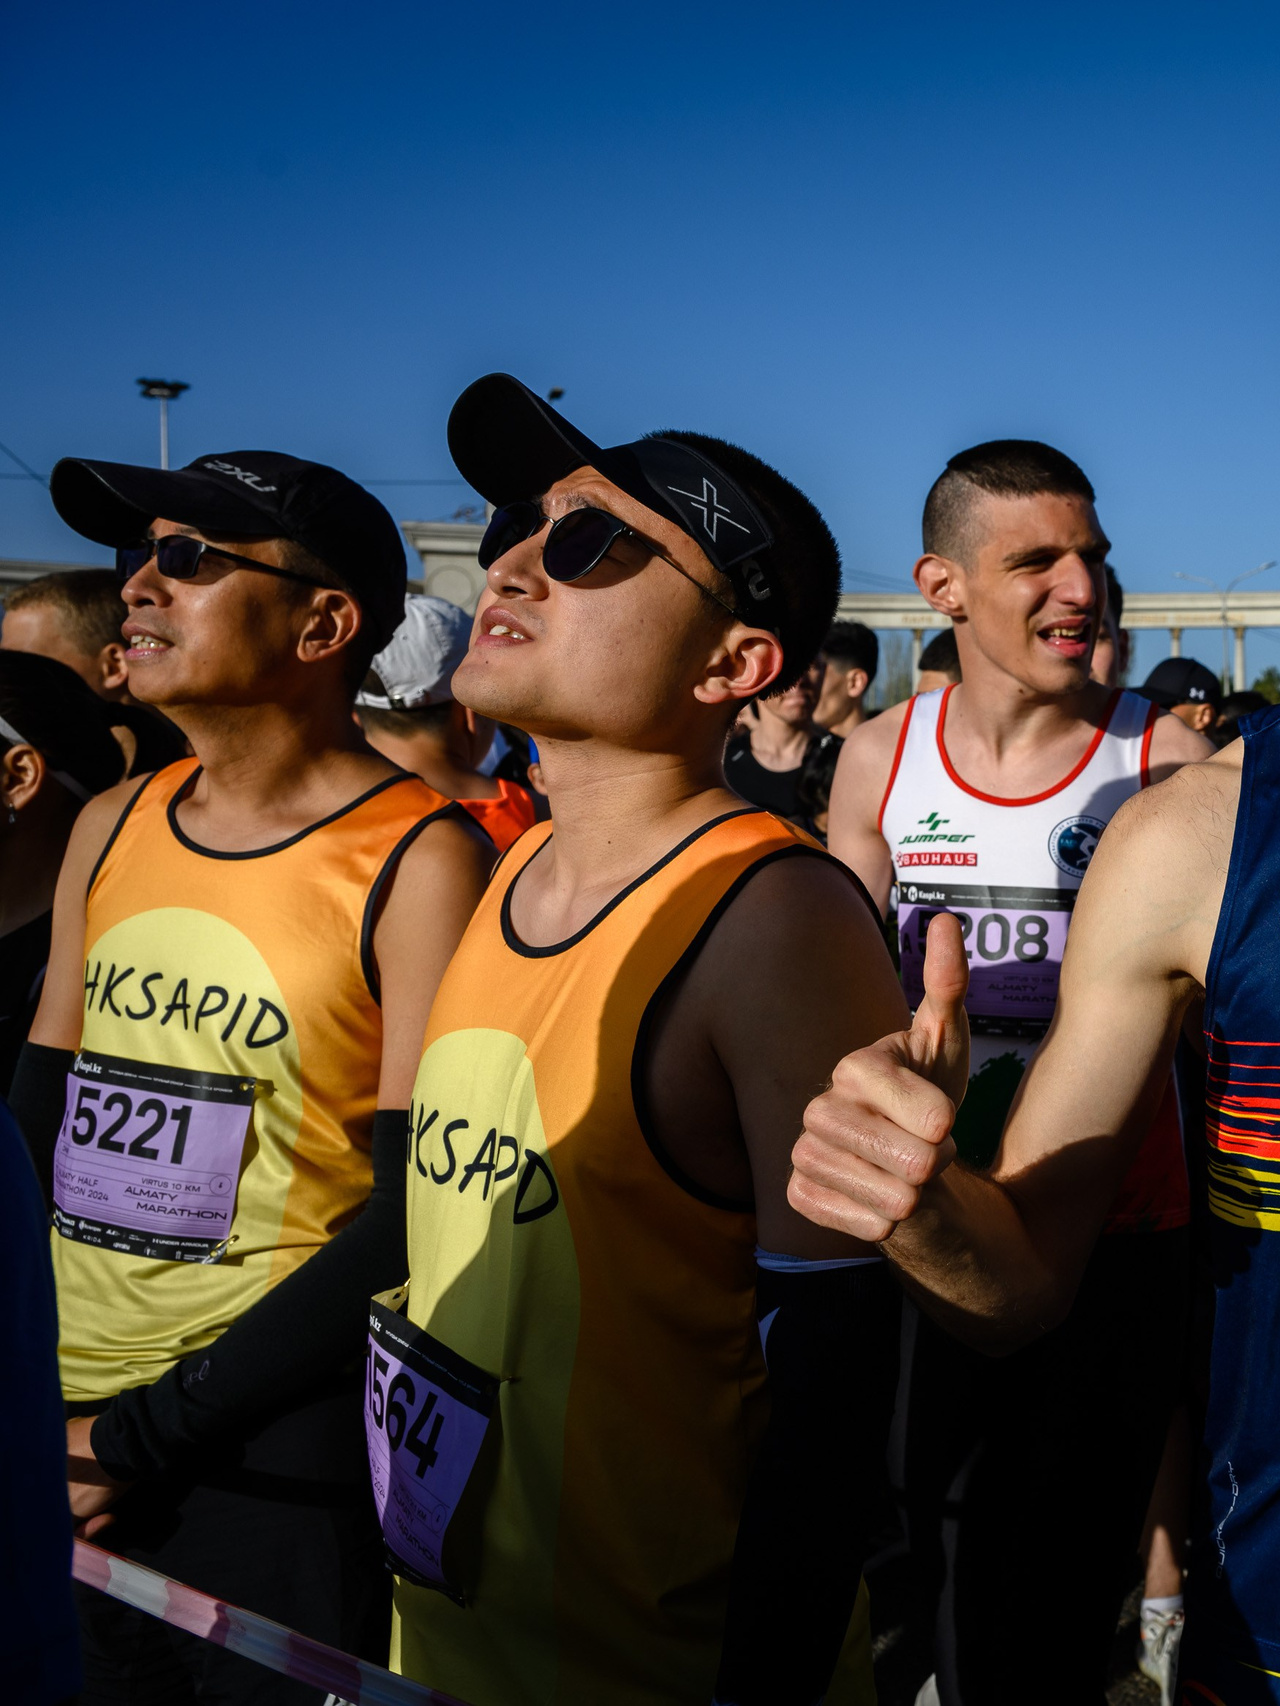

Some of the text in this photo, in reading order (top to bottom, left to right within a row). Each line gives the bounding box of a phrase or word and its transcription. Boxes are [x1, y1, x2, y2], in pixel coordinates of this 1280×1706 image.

[898, 834, 976, 845] JUMPER
[902, 853, 977, 866] BAUHAUS
[988, 983, 1038, 992] ALMATY
[85, 960, 289, 1049] HKSAPID
[1002, 995, 1058, 1003] MARATH
[71, 1085, 193, 1165] 5221
[141, 1177, 201, 1193] VIRTUS 10 KM
[87, 1189, 109, 1202] 2024
[124, 1186, 179, 1202] ALMATY
[136, 1202, 228, 1221] MARATHON
[396, 1514, 441, 1568] MARATHON
